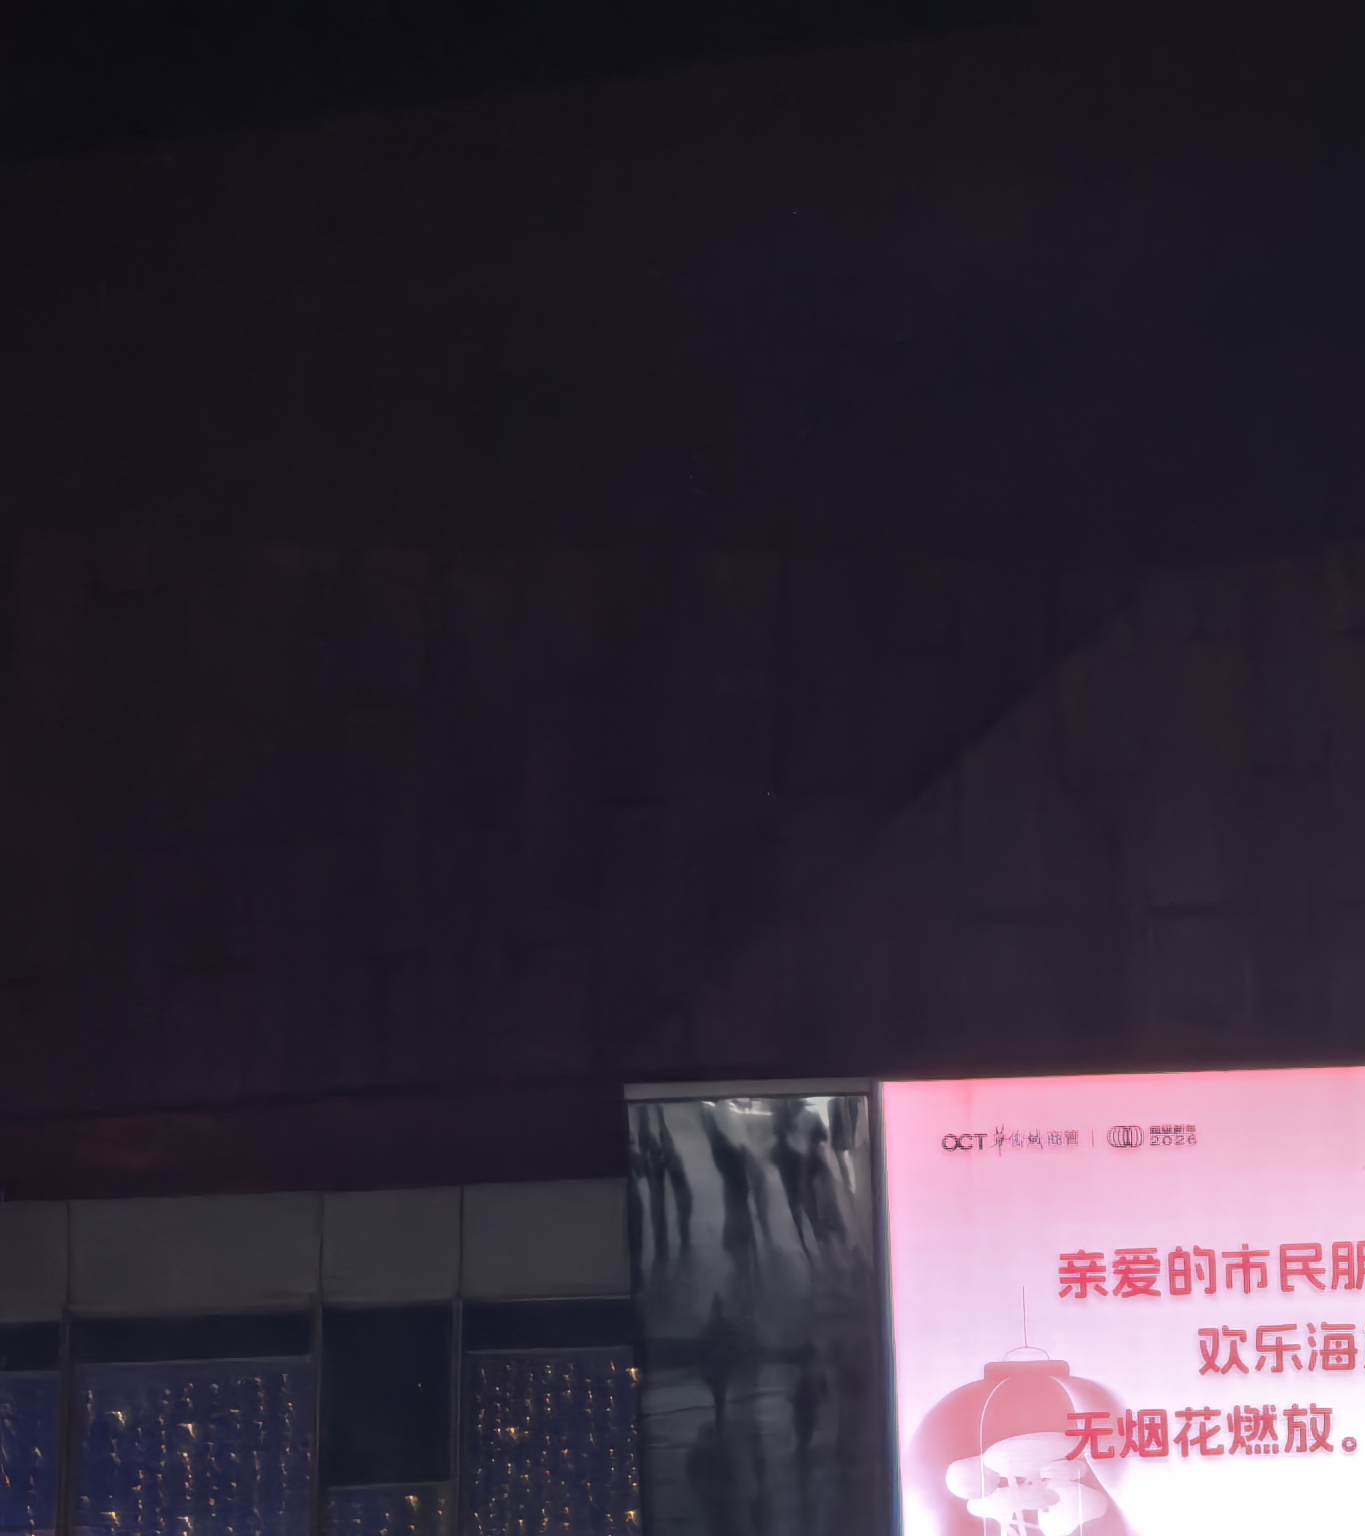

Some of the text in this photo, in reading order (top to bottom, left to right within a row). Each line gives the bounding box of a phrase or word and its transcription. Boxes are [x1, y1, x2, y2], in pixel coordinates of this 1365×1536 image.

[942, 1133, 987, 1151] OCT
[1065, 1402, 1358, 1461] 无烟花燃放。
